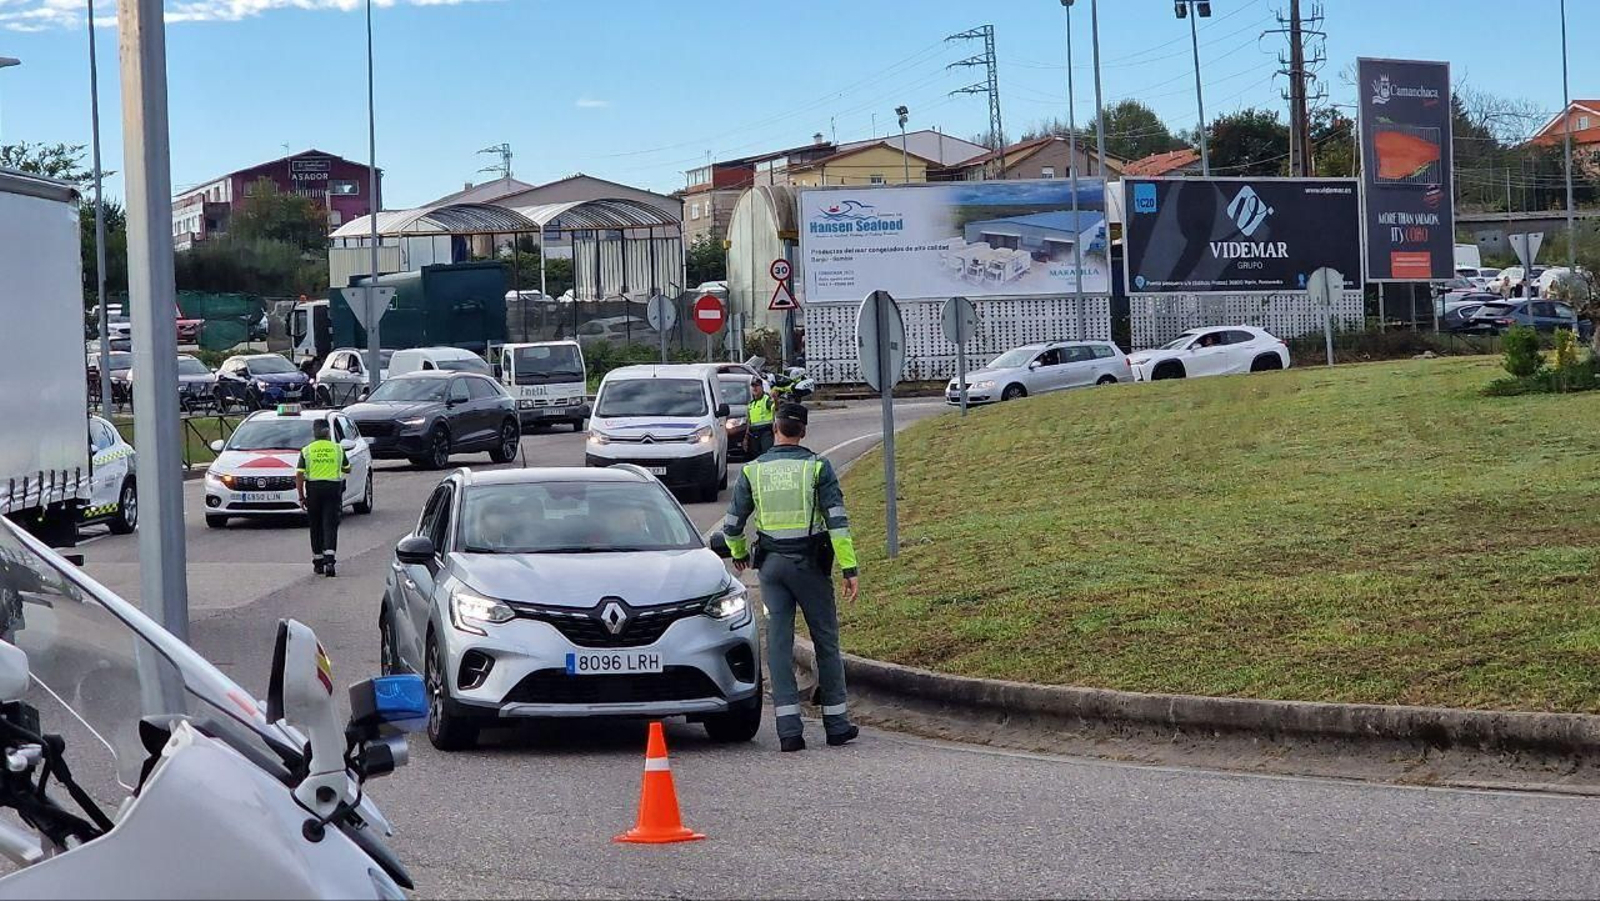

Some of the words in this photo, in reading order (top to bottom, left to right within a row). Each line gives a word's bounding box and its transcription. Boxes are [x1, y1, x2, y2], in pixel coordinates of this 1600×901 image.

[1390, 84, 1439, 98] Camanchaca
[291, 173, 329, 181] ASADOR
[1379, 212, 1397, 225] MORE
[1397, 212, 1414, 225] THAN
[810, 221, 853, 233] Hansen
[856, 219, 903, 231] Seafood
[868, 246, 904, 254] congelados
[1209, 242, 1289, 258] VIDEMAR
[774, 266, 788, 274] 30
[1237, 261, 1263, 270] GRUPO
[579, 655, 621, 671] 8096
[627, 654, 659, 670] LRH
